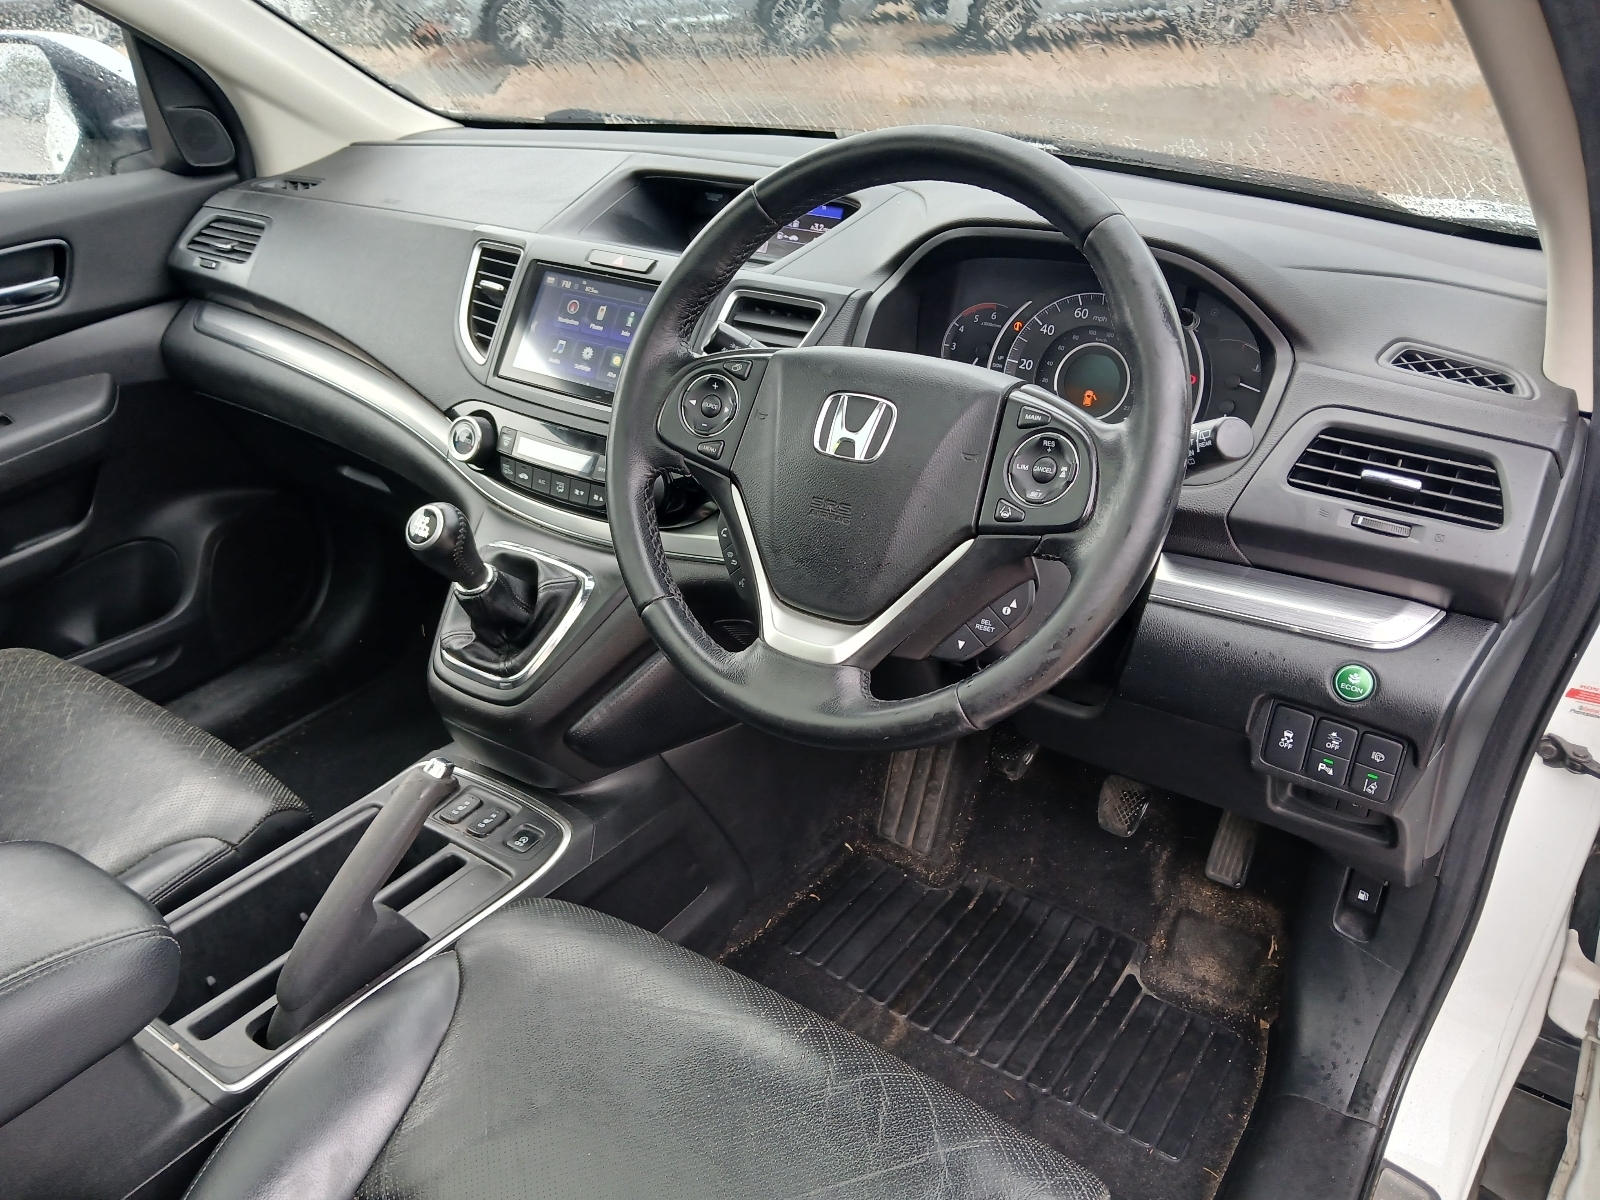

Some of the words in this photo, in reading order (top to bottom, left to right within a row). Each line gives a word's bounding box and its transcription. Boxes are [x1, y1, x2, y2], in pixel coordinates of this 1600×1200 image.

[562, 280, 572, 289] FM
[973, 314, 980, 323] 5
[991, 311, 997, 320] 6
[1074, 308, 1089, 320] 60
[1092, 313, 1108, 323] mph
[958, 325, 965, 333] 4
[1039, 324, 1056, 336] 40
[950, 342, 957, 351] 3
[1018, 358, 1034, 371] 20
[1024, 413, 1042, 421] MAIN
[1042, 439, 1056, 448] RES
[1199, 440, 1212, 448] REAR
[702, 444, 717, 453] MENU
[1016, 463, 1029, 471] LIM
[1033, 465, 1053, 475] CANCEL
[1029, 491, 1042, 499] SET
[980, 618, 992, 626] SEL
[975, 623, 995, 633] RESET
[1340, 682, 1364, 695] ECON
[1278, 740, 1294, 750] OFF
[1325, 741, 1341, 751] OFF
